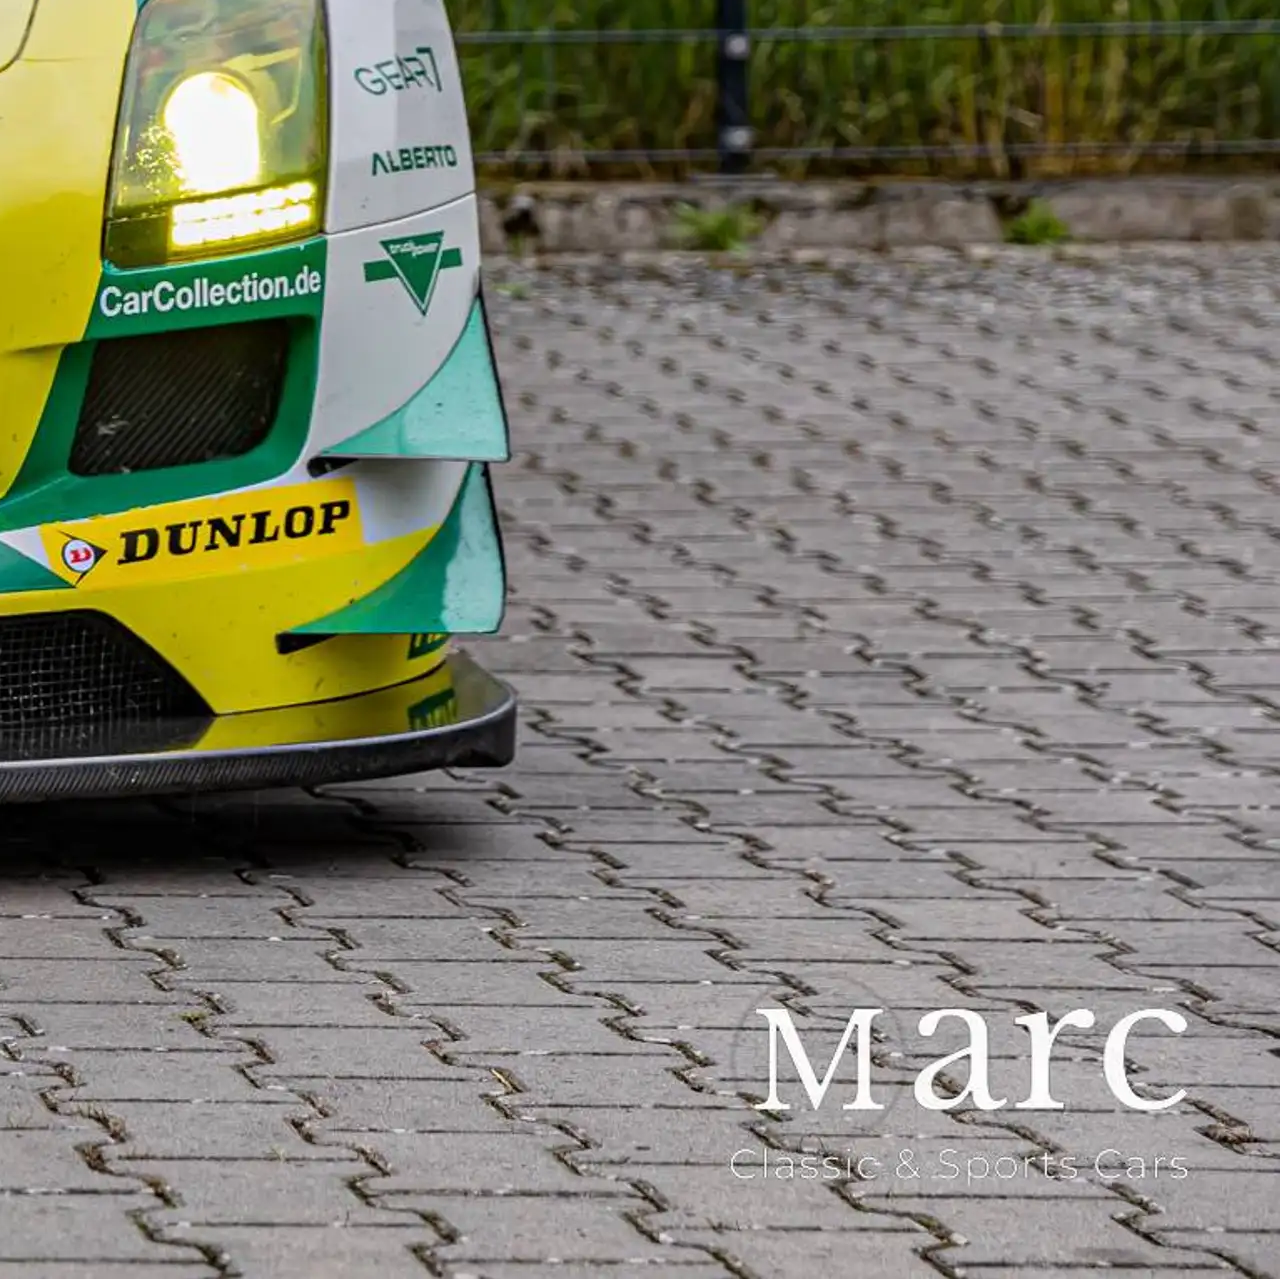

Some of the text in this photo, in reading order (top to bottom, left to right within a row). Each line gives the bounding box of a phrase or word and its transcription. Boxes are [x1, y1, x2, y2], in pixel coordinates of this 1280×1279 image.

[371, 144, 457, 177] ALBERTO
[100, 266, 321, 318] CarCollection.de
[117, 499, 351, 566] DUNLOP
